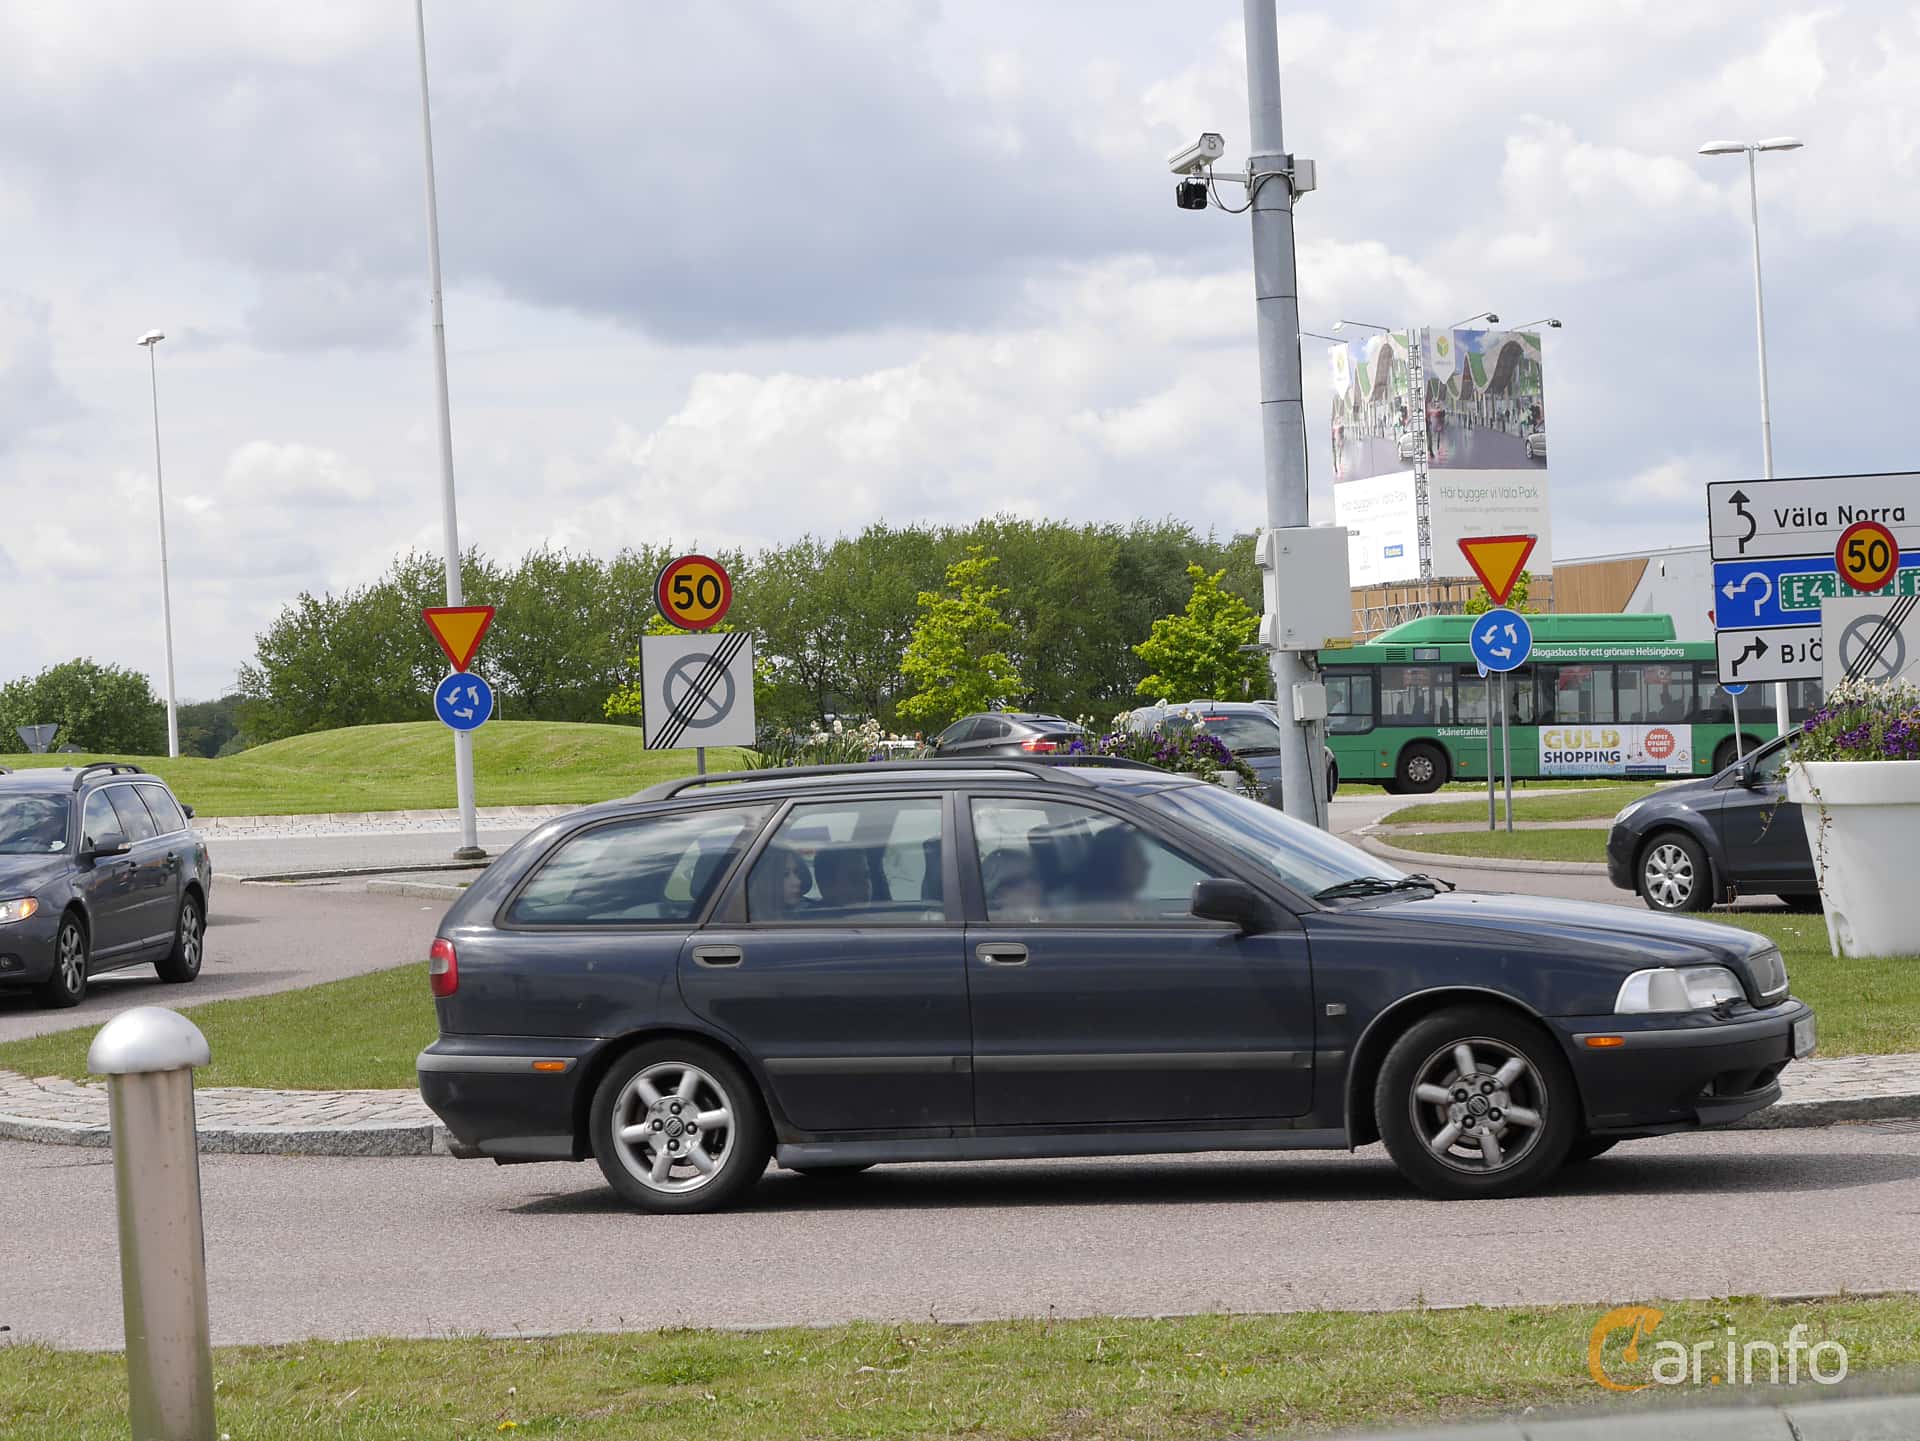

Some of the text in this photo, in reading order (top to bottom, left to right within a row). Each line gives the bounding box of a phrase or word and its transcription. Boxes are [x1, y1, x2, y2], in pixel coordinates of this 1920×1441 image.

[1519, 486, 1538, 498] Park
[1774, 505, 1905, 528] Väla Norra
[1848, 539, 1890, 573] 50
[673, 574, 721, 610] 50
[1532, 647, 1685, 658] Biogasbuss för ett grönare Helsingborg
[1543, 729, 1620, 749] GULD
[1543, 750, 1621, 764] SHOPPING
